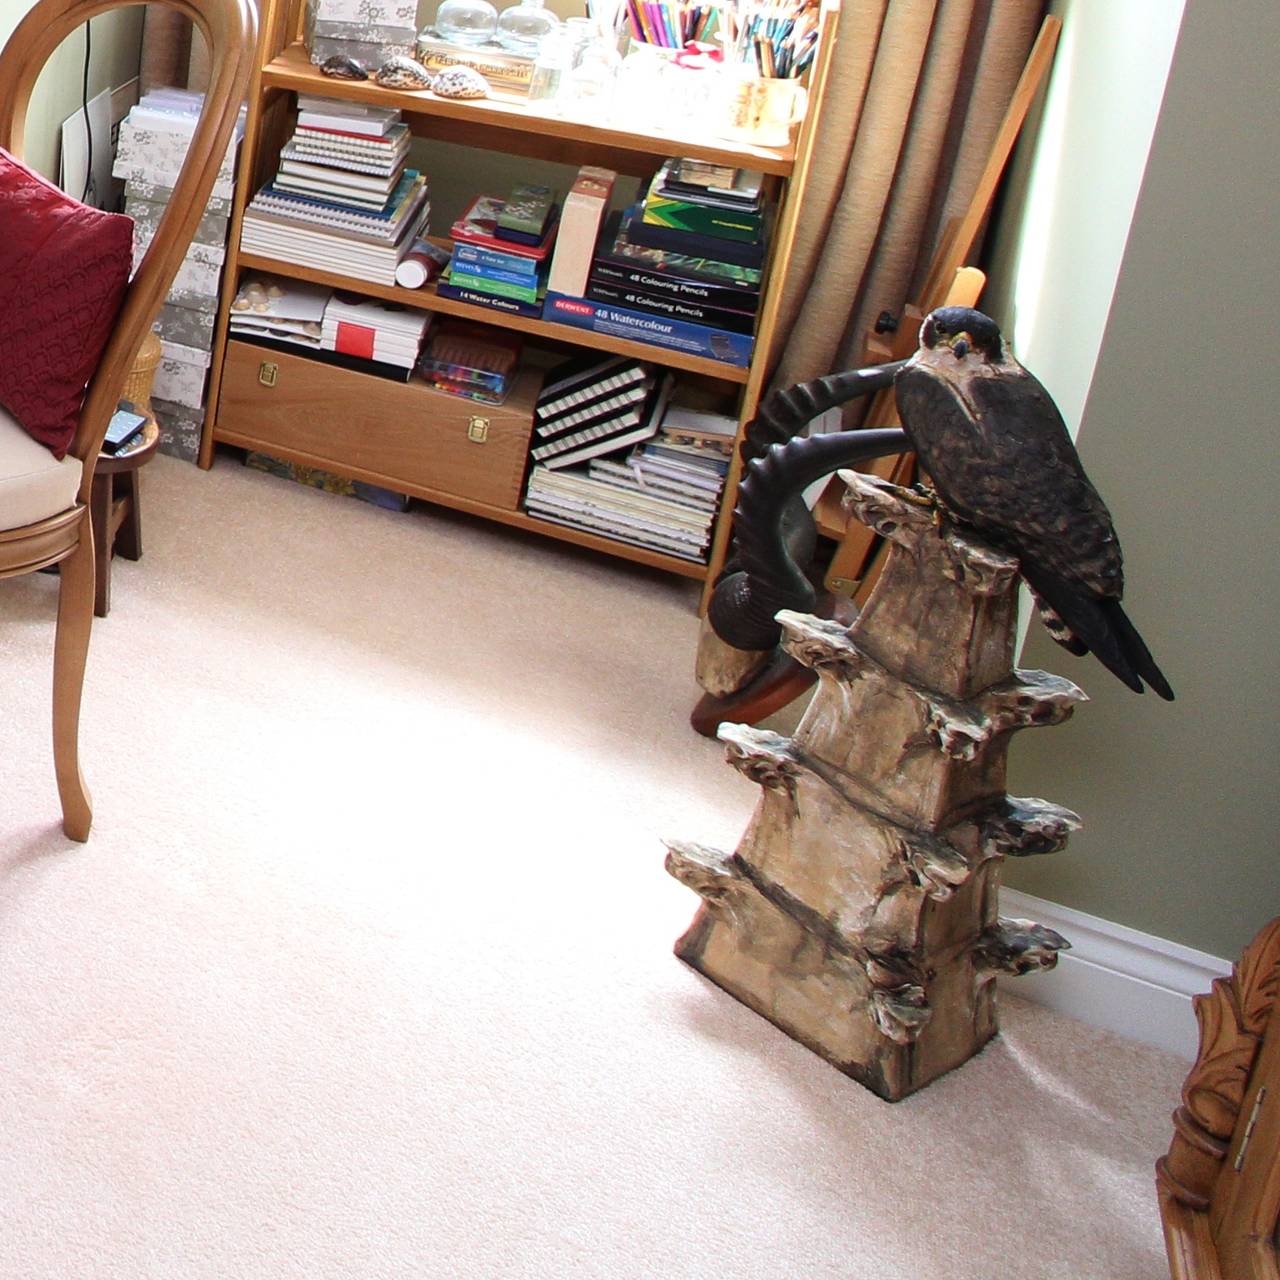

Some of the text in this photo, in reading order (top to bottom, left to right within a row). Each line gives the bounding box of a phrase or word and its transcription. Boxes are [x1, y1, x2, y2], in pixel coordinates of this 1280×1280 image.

[629, 273, 708, 297] 48 Colouring Pencils
[469, 293, 490, 303] Water
[492, 299, 519, 310] Colours
[555, 300, 590, 314] DERWENT
[625, 294, 703, 318] 48 Colouring Pencils
[595, 308, 673, 333] 48 Watercolour
